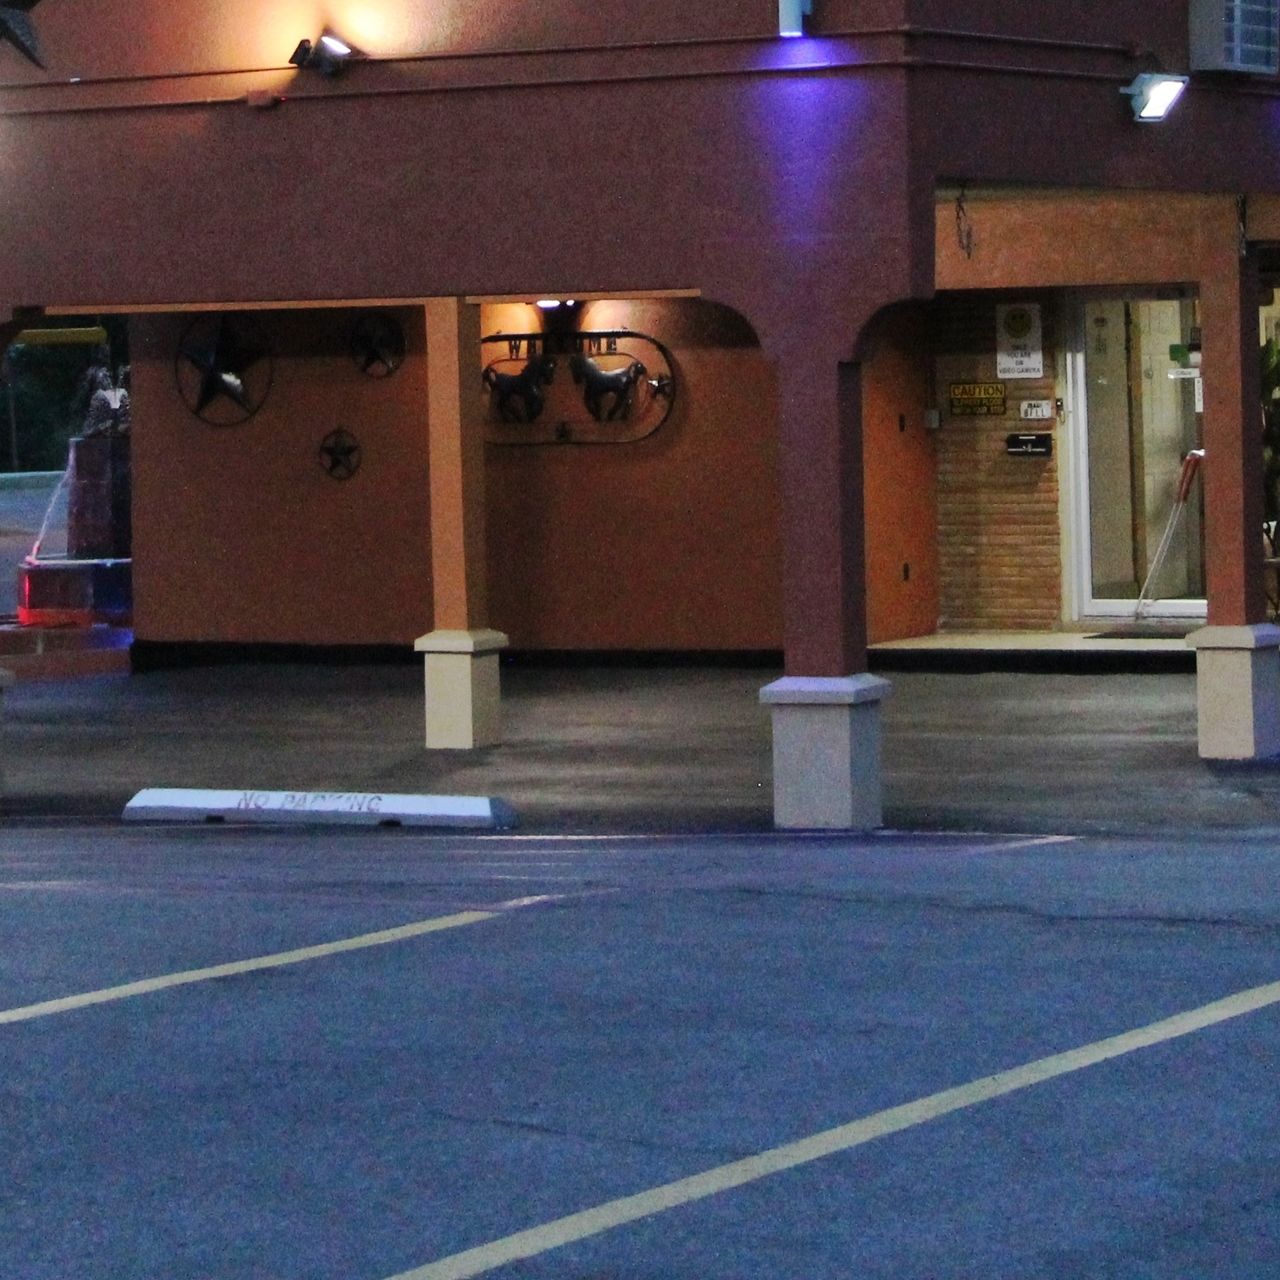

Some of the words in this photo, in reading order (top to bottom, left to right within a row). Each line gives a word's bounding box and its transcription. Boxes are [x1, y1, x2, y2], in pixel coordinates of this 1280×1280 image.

[508, 337, 617, 358] WEOME
[952, 385, 1003, 397] CAUTION
[237, 791, 270, 810] NO
